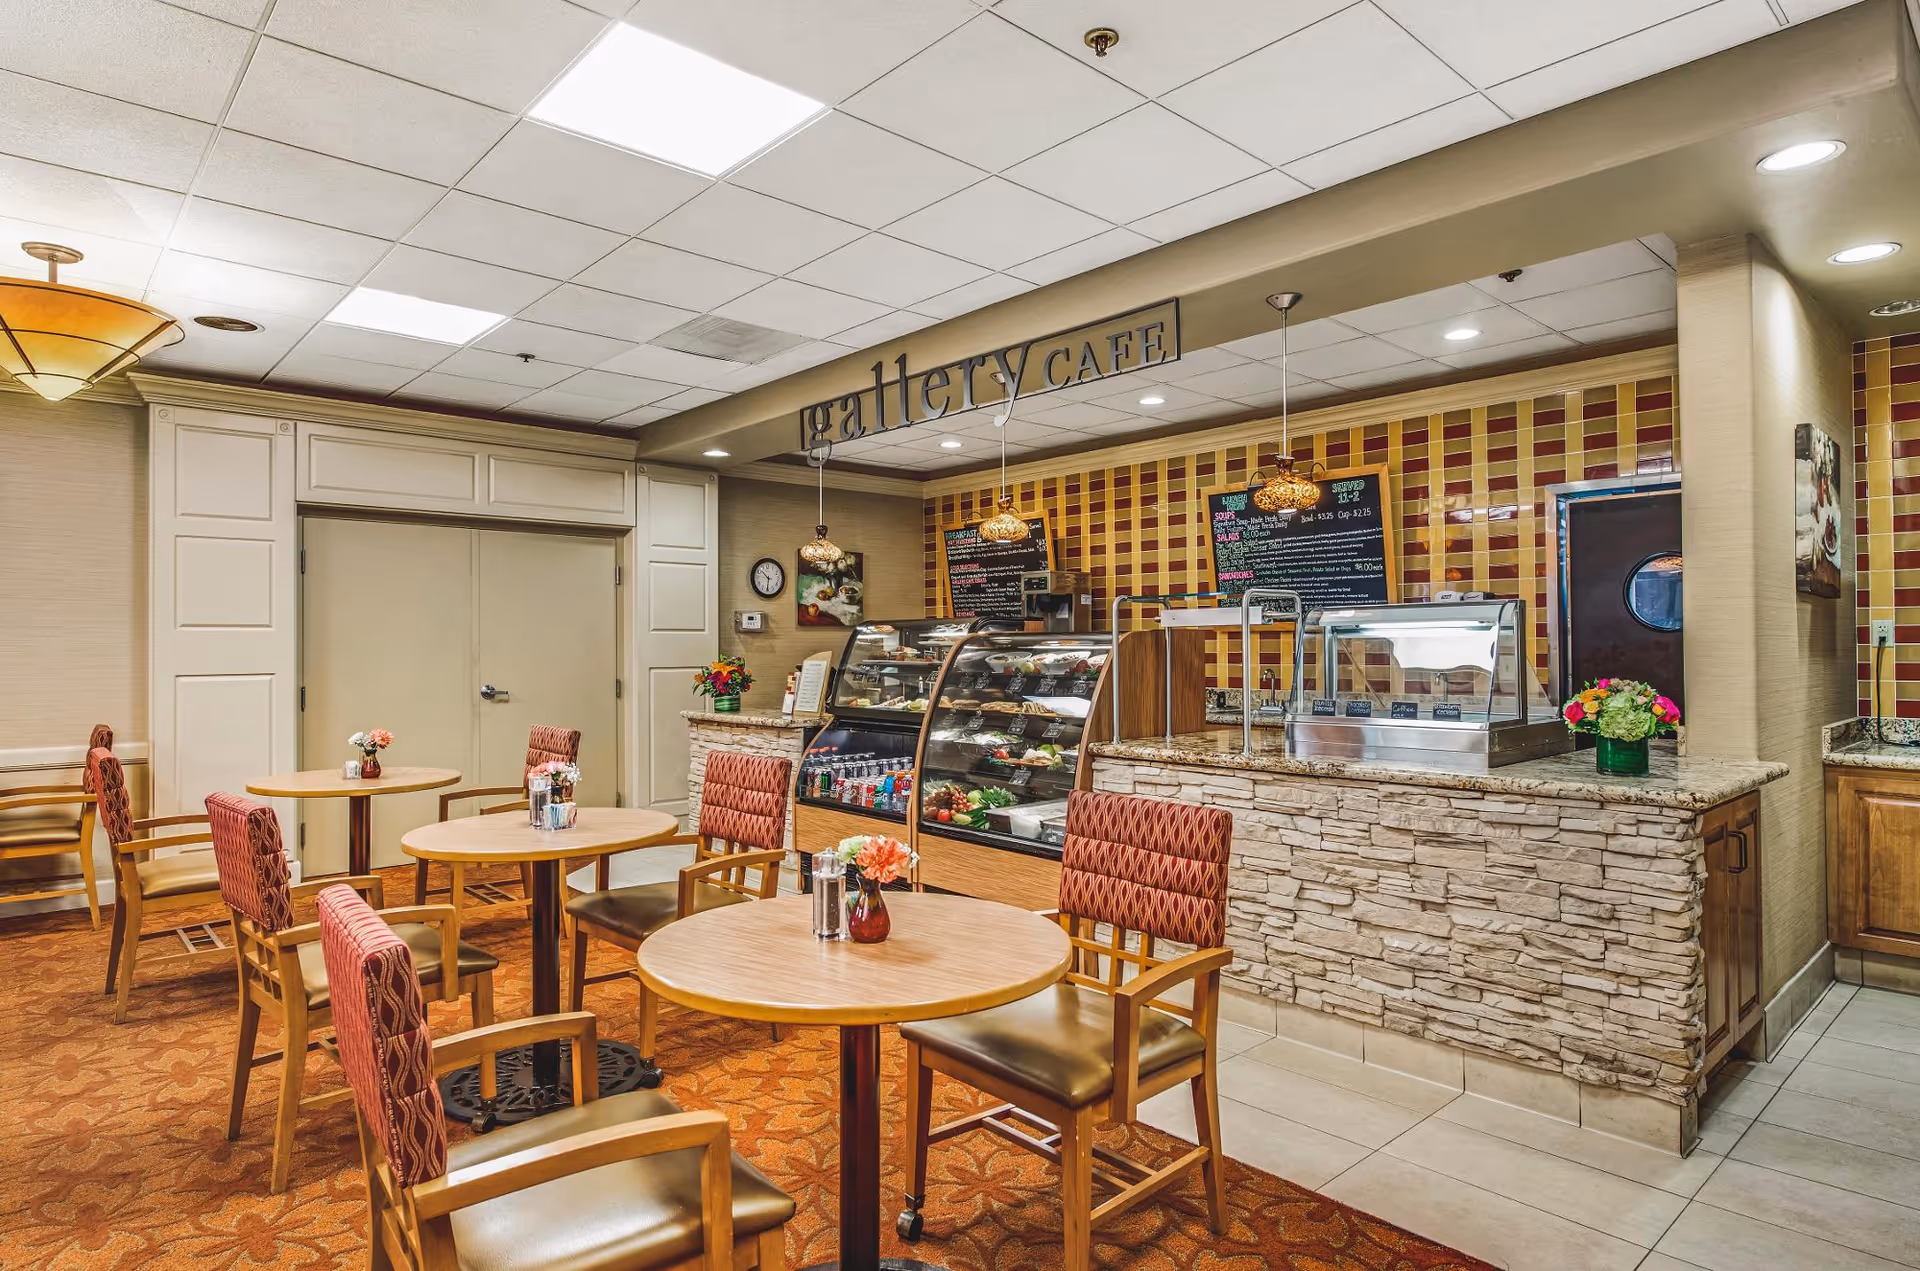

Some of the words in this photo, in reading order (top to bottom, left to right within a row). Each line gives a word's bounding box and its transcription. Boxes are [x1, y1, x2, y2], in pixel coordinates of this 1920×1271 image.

[806, 342, 1034, 468] gallery
[1043, 321, 1168, 391] CAFE
[1332, 479, 1365, 493] SERVED
[1214, 511, 1236, 521] SOUPS
[1216, 532, 1240, 542] SALADS
[1217, 570, 1254, 581] SANDWICHES
[1392, 704, 1416, 712] Coffee
